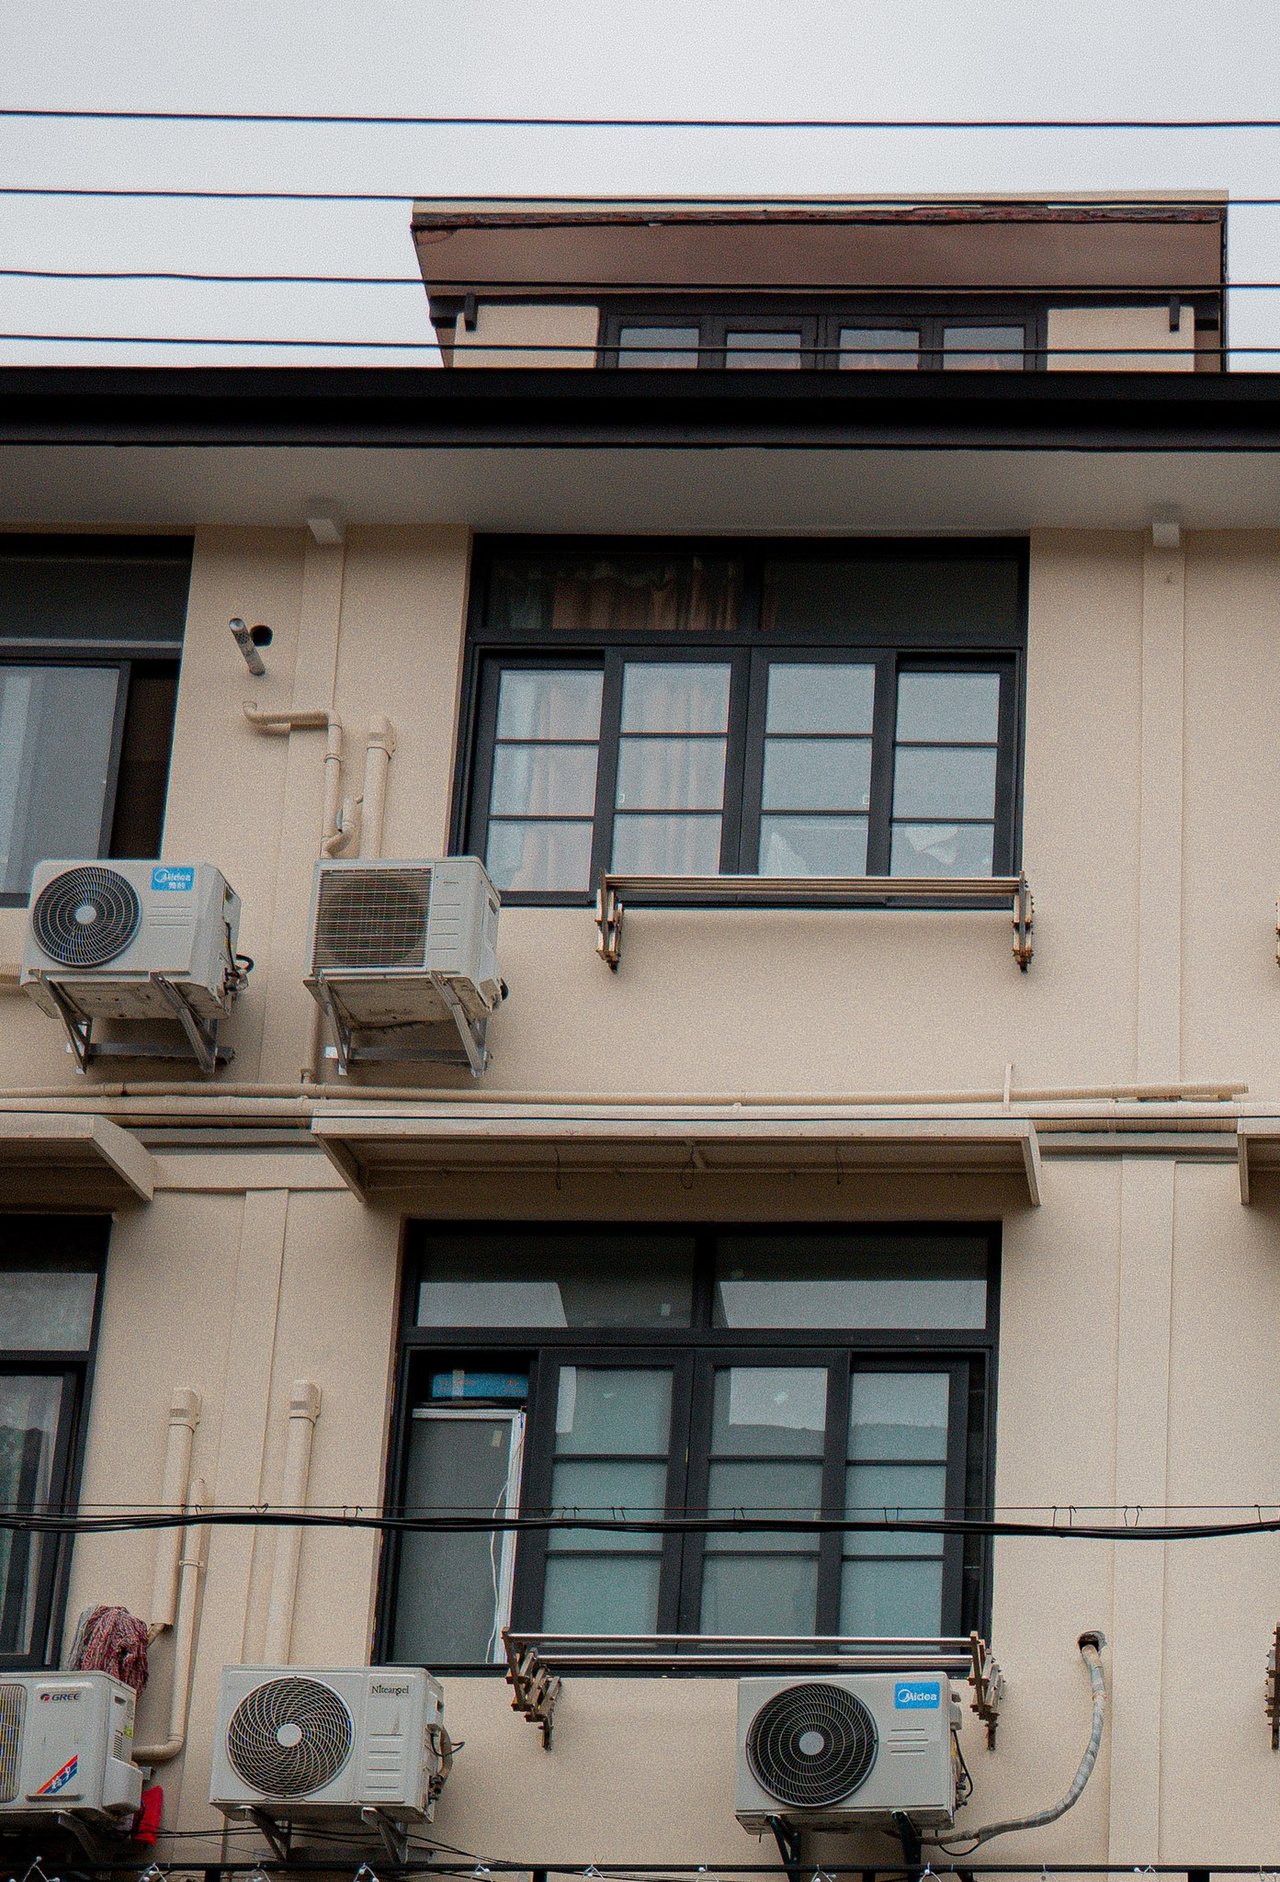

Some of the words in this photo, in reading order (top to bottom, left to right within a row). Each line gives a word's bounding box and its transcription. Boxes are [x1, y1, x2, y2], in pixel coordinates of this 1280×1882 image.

[155, 868, 191, 883] Midea
[51, 1693, 80, 1701] GREE
[898, 1688, 938, 1703] Midea
